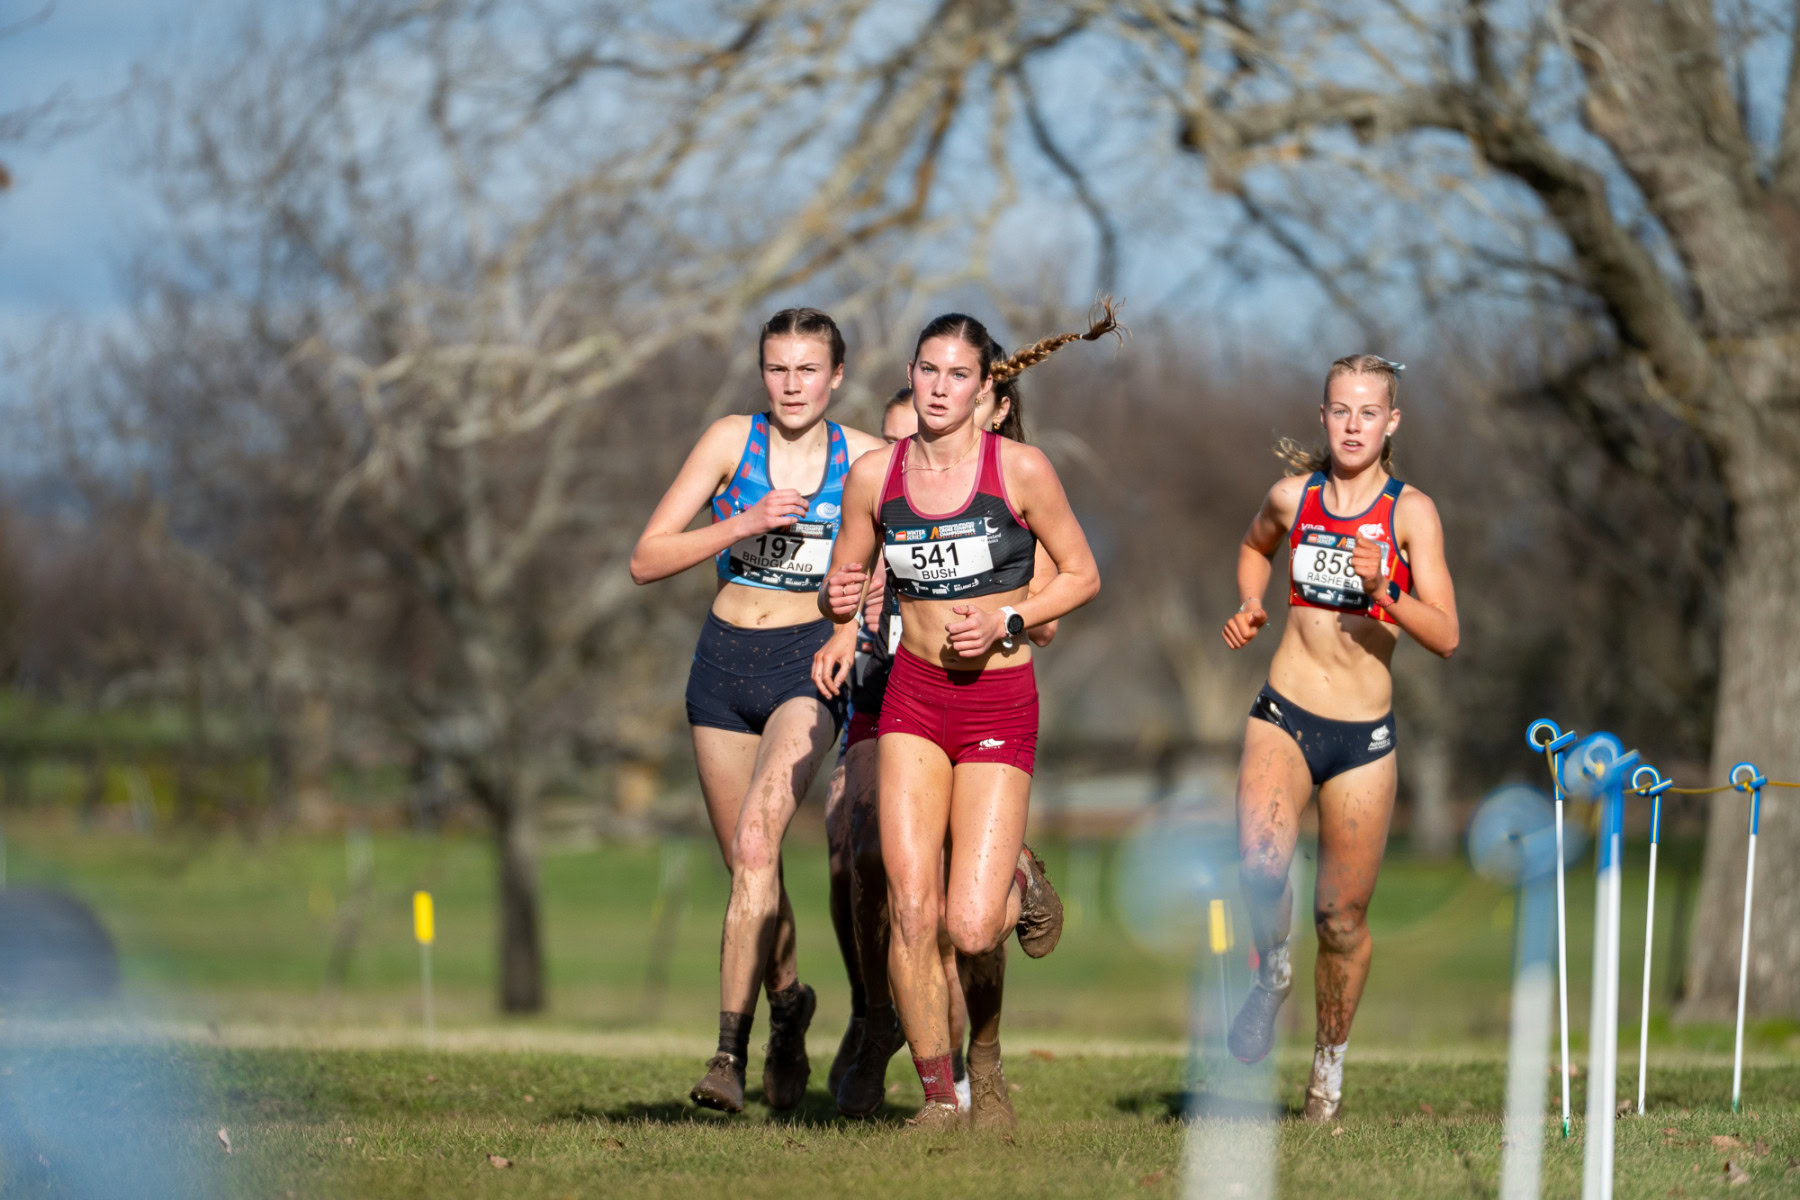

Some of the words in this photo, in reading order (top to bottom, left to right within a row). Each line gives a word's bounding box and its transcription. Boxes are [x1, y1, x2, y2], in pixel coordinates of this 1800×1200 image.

[756, 535, 805, 560] 197
[911, 542, 959, 570] 541
[742, 551, 813, 572] BRIDGLAND
[1314, 550, 1356, 577] 858
[922, 568, 957, 580] BUSH
[1307, 572, 1359, 589] RASHEED
